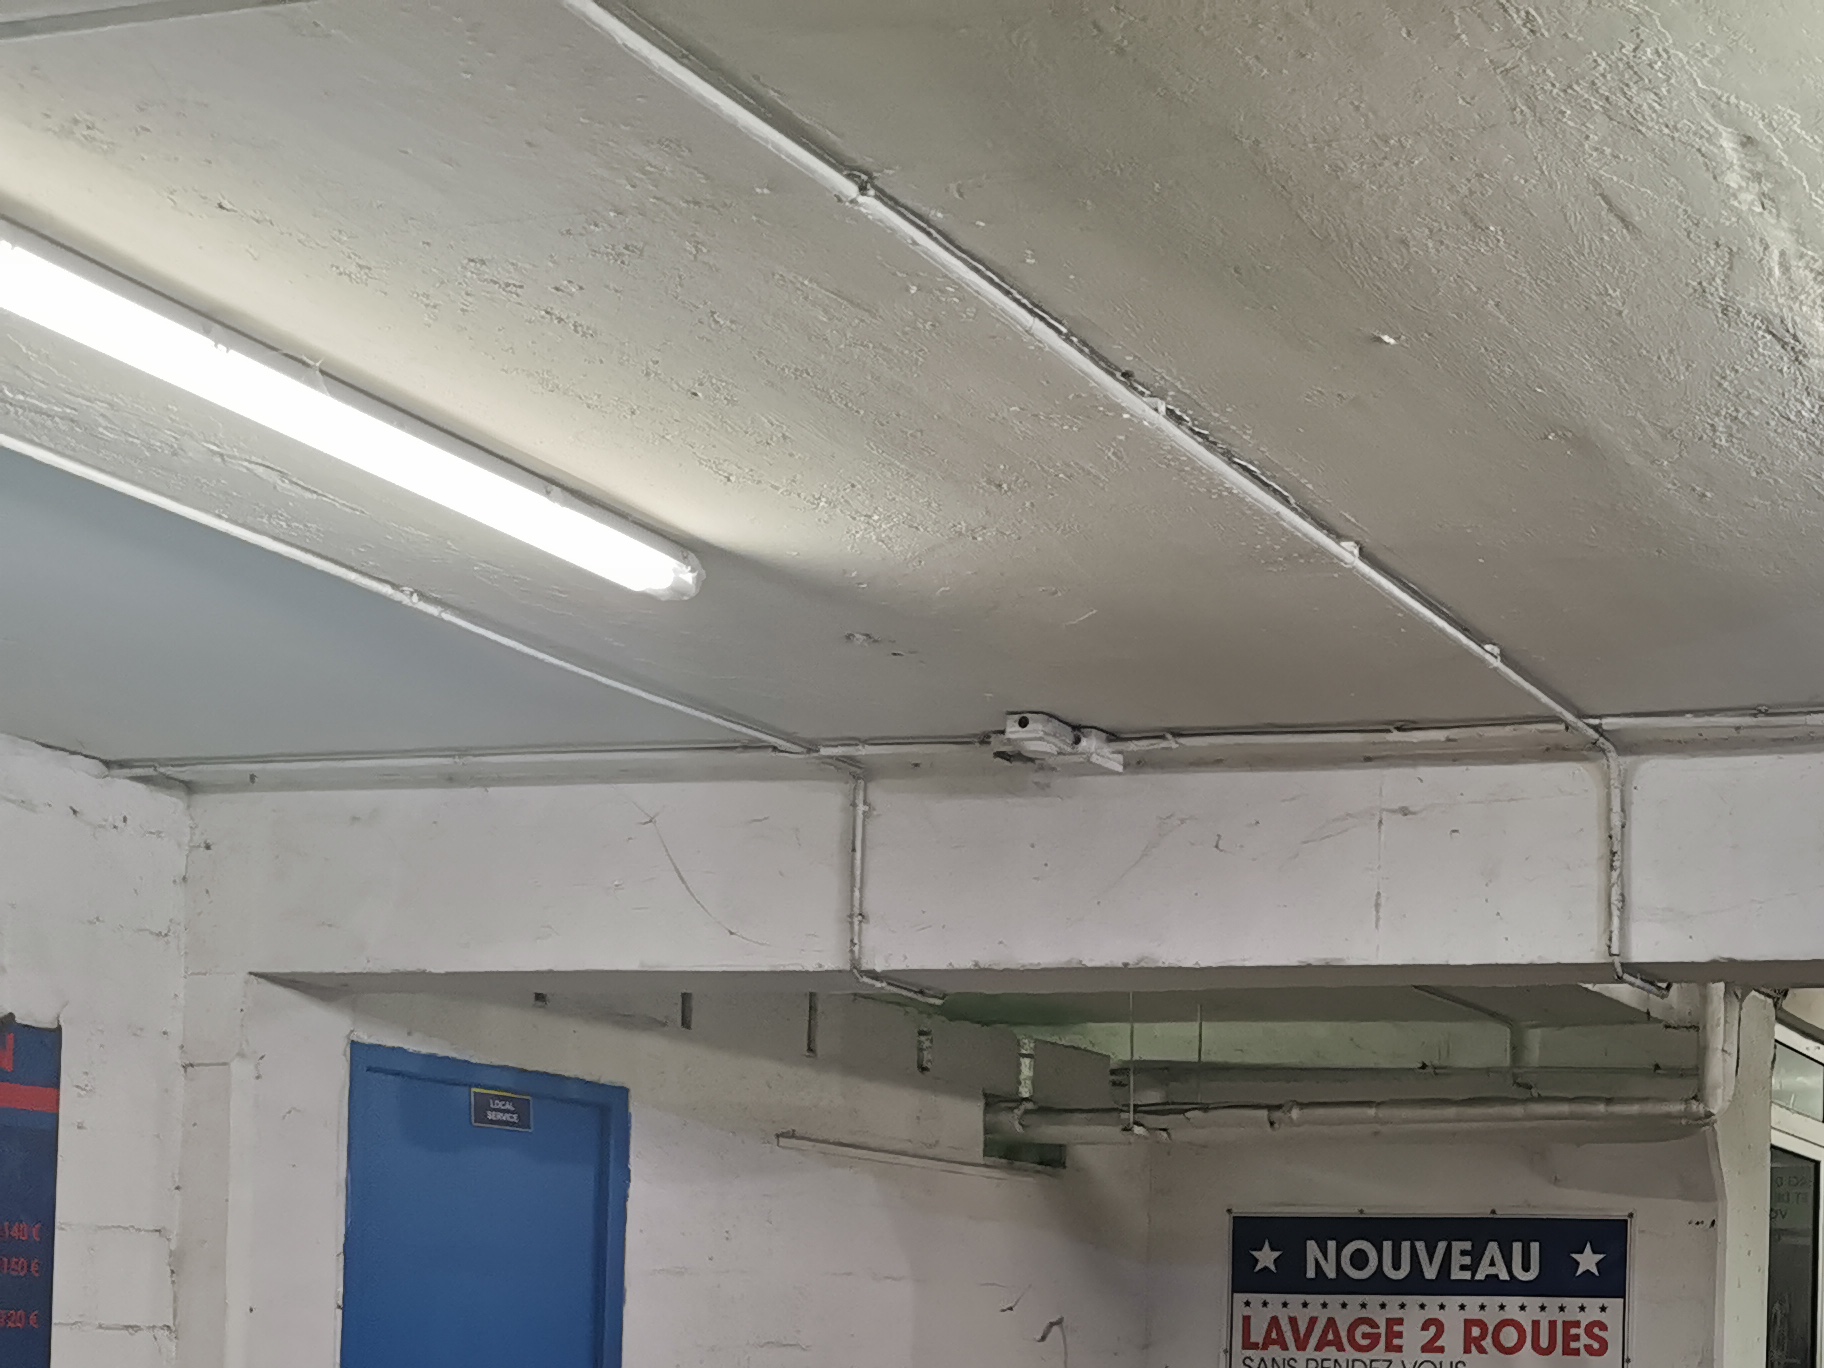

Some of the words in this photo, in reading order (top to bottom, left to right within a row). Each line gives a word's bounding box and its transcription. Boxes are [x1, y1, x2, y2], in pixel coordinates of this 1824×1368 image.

[486, 1110, 519, 1123] SERVICE
[489, 1099, 516, 1111] LOCAL
[1305, 1239, 1541, 1281] NOUVEAU
[1241, 1315, 1405, 1353] LAVAGE
[1420, 1318, 1447, 1355] 2
[1462, 1319, 1610, 1357] ROUES
